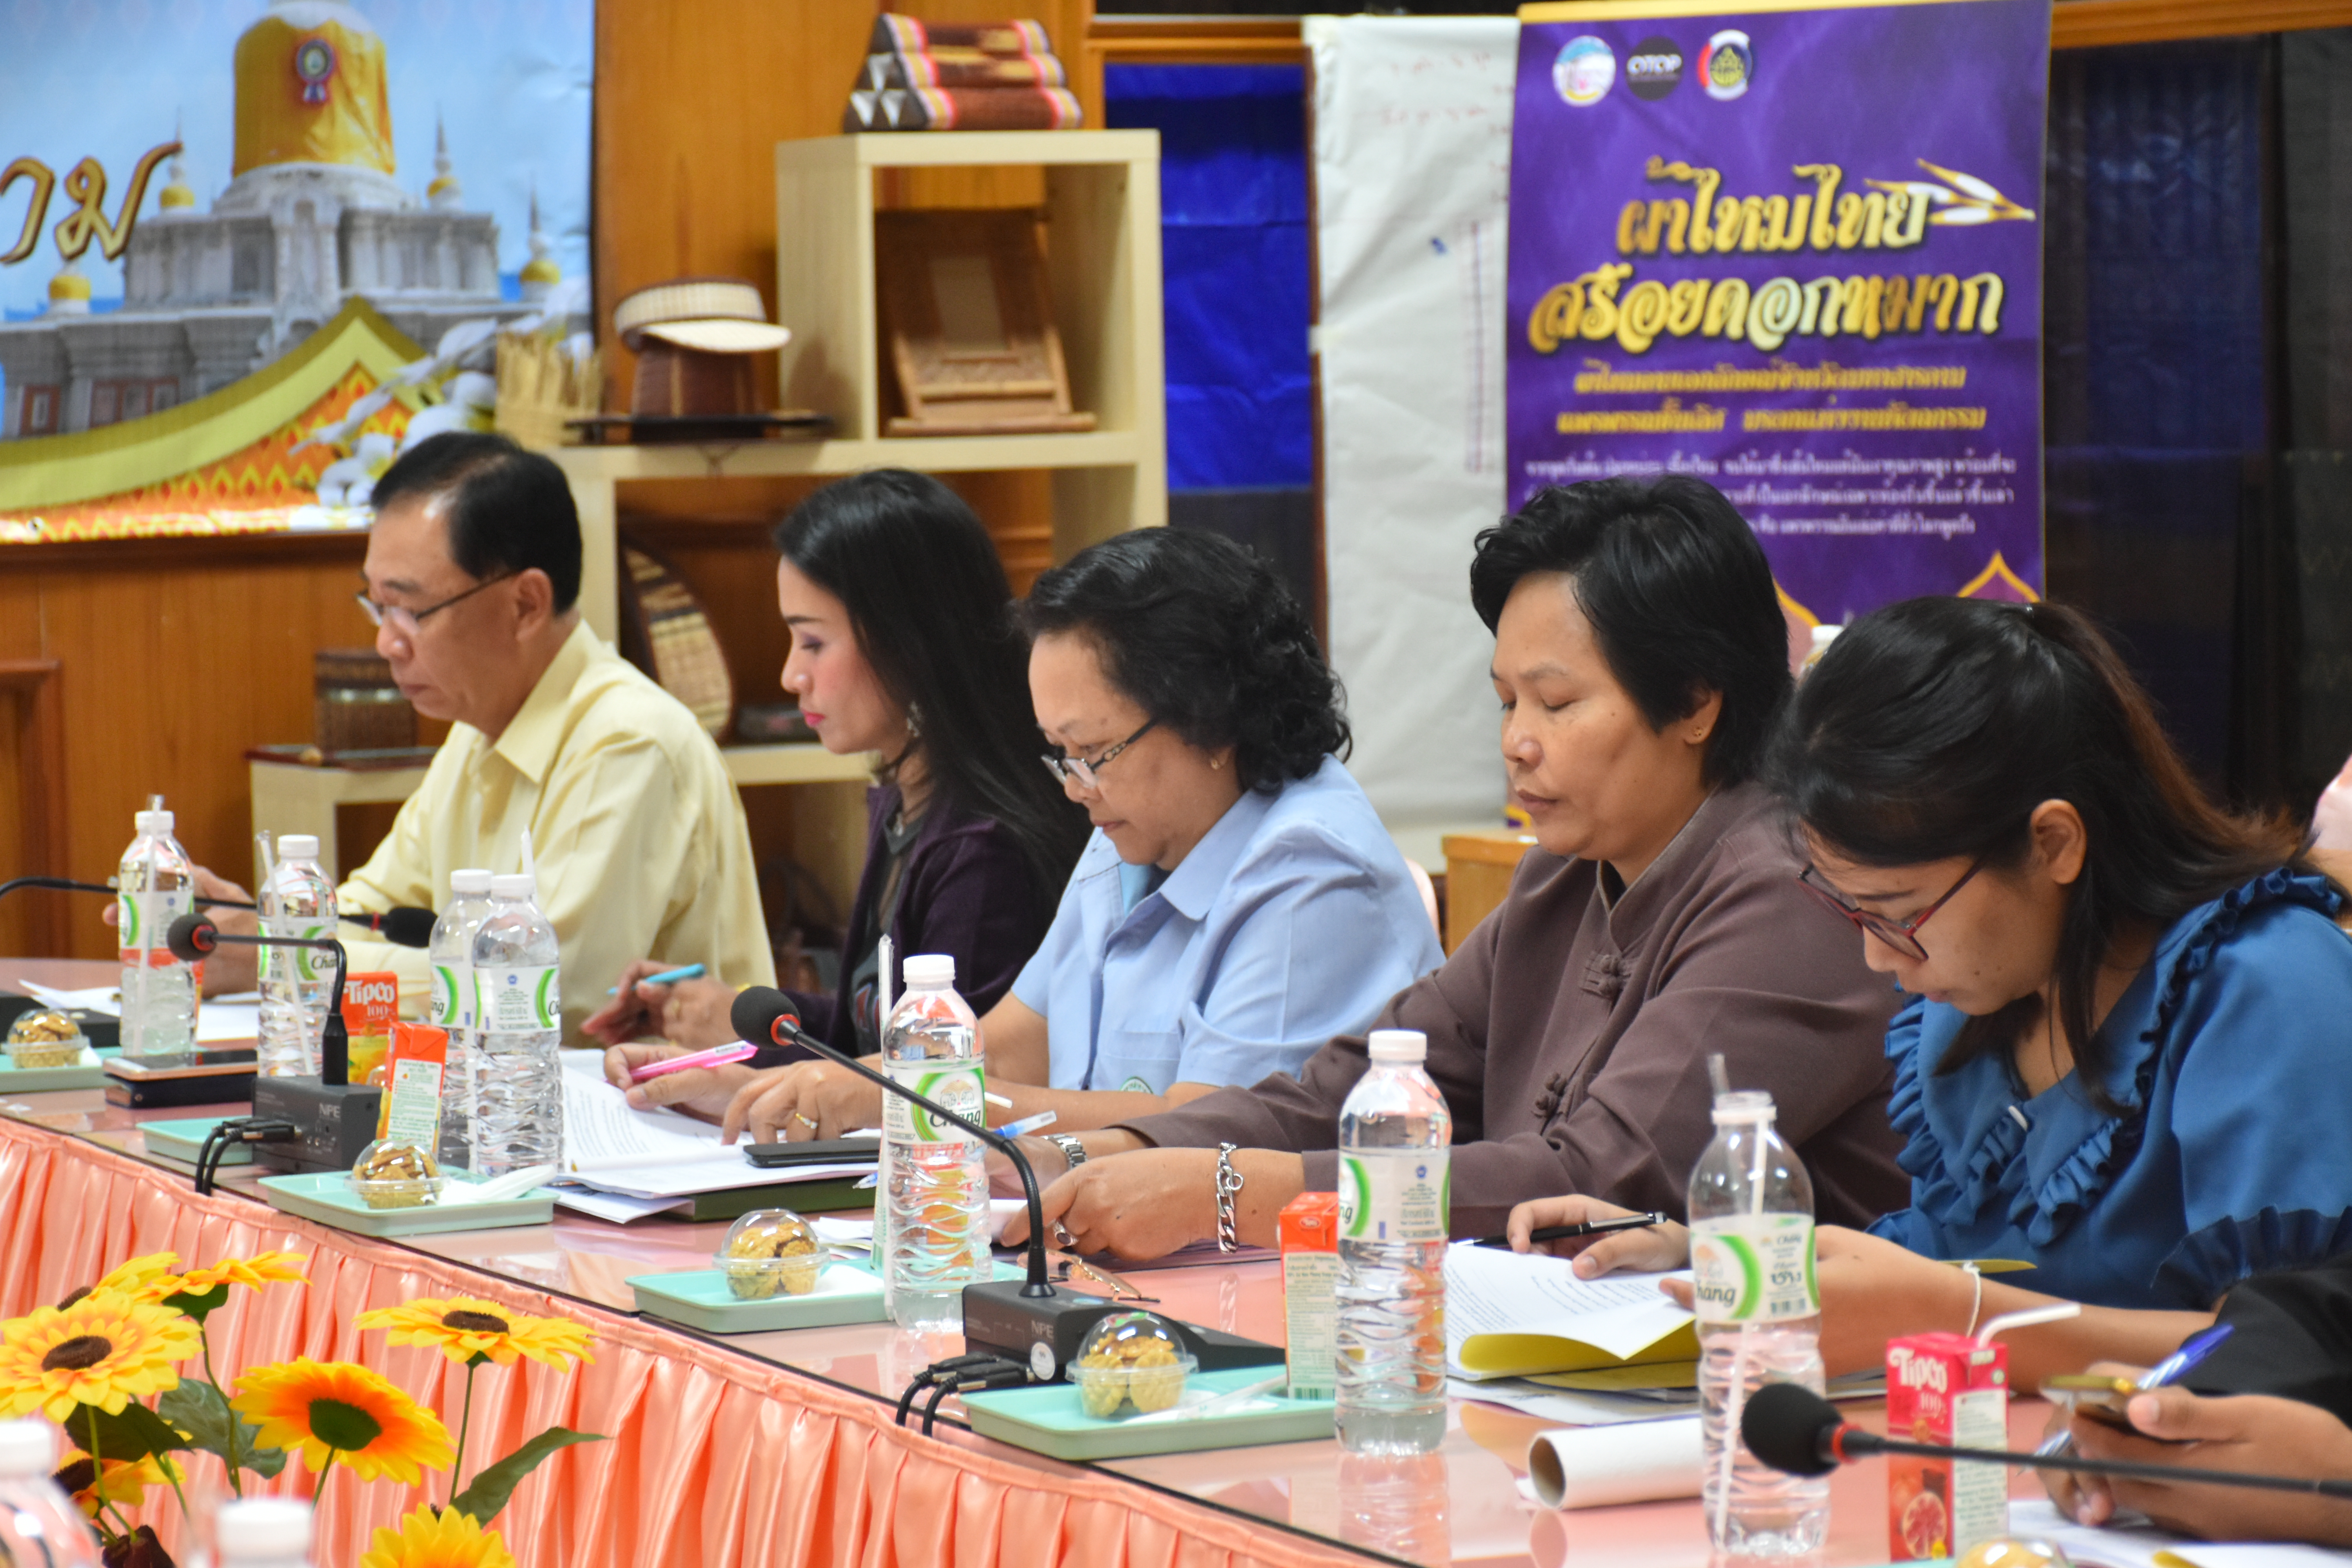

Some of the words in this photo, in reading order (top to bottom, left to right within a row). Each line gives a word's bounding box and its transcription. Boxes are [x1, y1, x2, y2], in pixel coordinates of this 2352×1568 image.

[1627, 54, 1682, 75] OTOP
[1616, 154, 1931, 254] ผ้าไหมไทย
[311, 954, 336, 970] Cha
[343, 980, 394, 1005] Tipco
[1695, 1279, 1736, 1308] hang
[1889, 1347, 1948, 1394] Tipco
